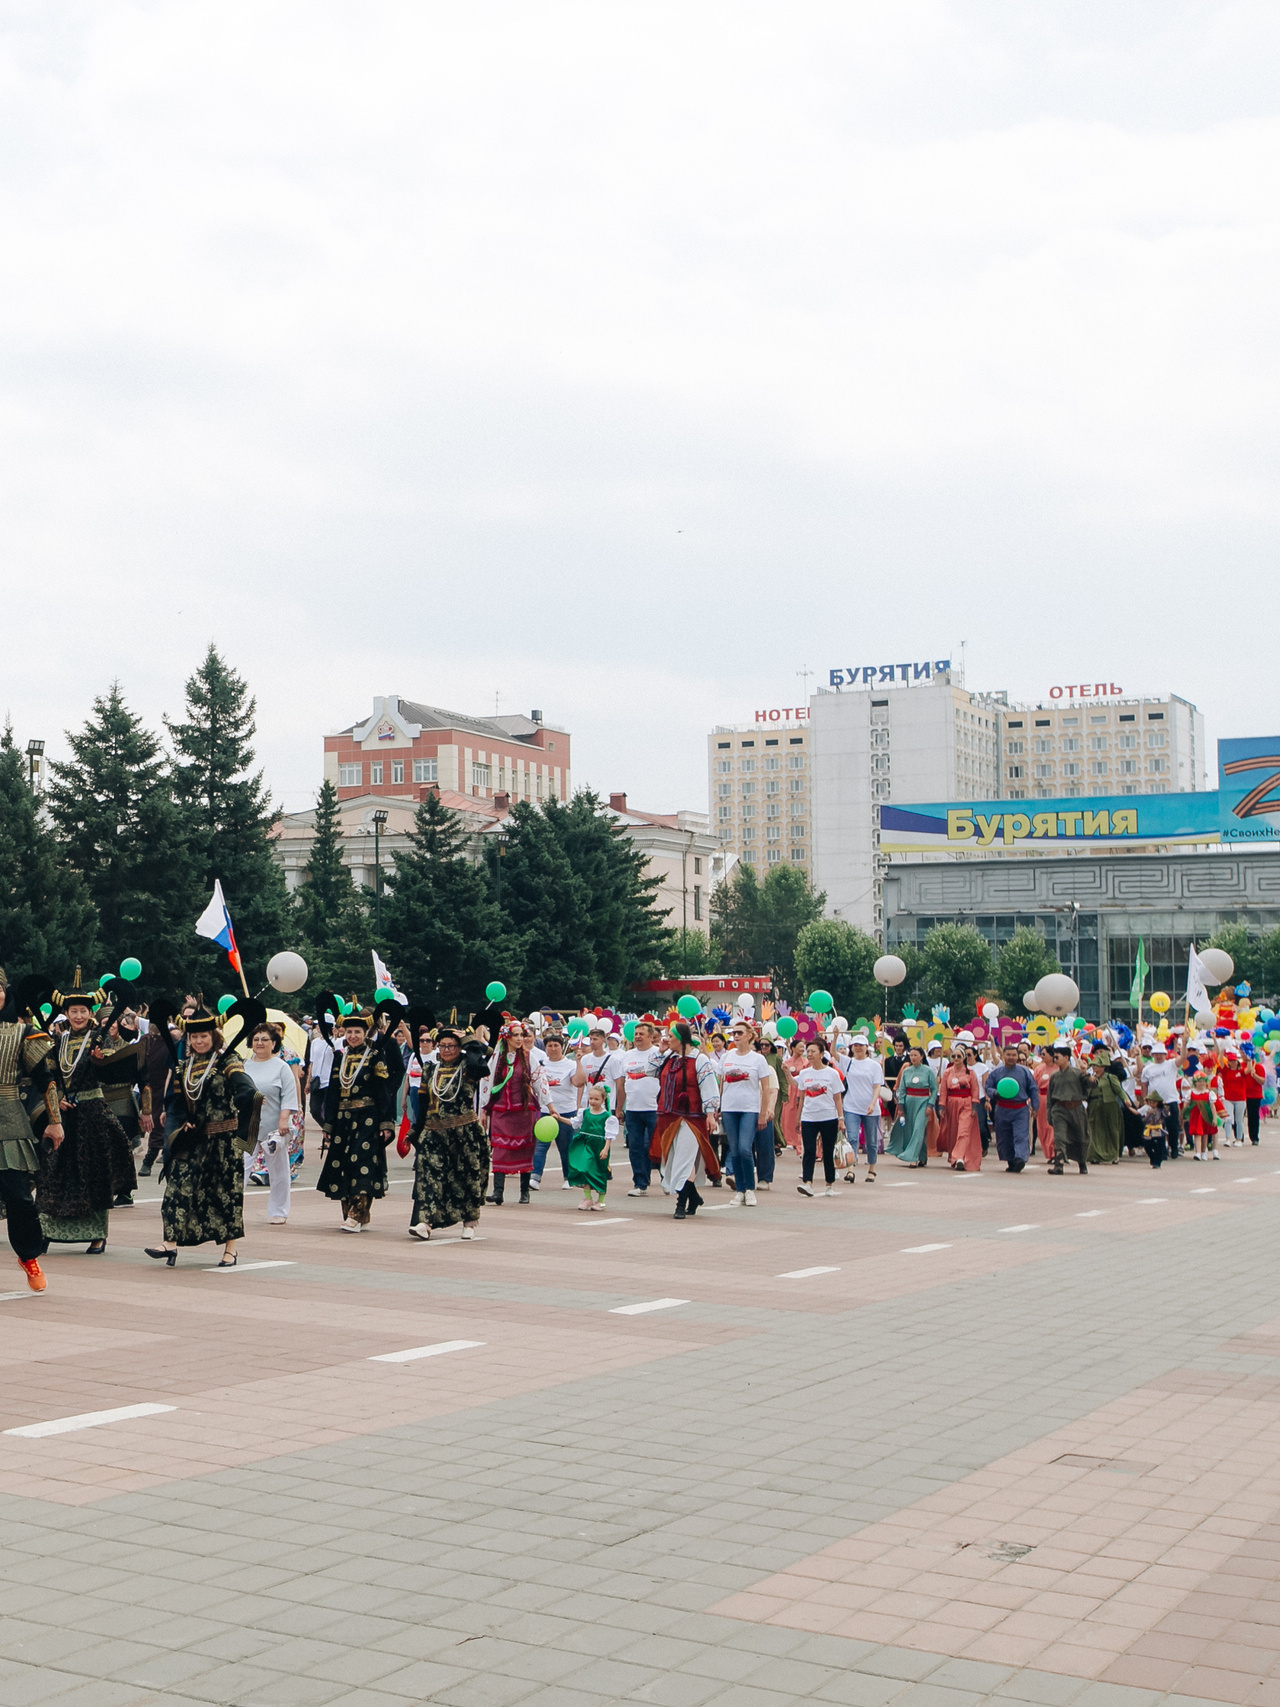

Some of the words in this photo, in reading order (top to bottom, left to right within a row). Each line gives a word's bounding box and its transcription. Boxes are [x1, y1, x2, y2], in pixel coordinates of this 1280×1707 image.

[829, 659, 951, 687] БУРЯТИЯ
[1049, 682, 1123, 700] ОТЕЛЬ
[946, 808, 1139, 847] Бурятия
